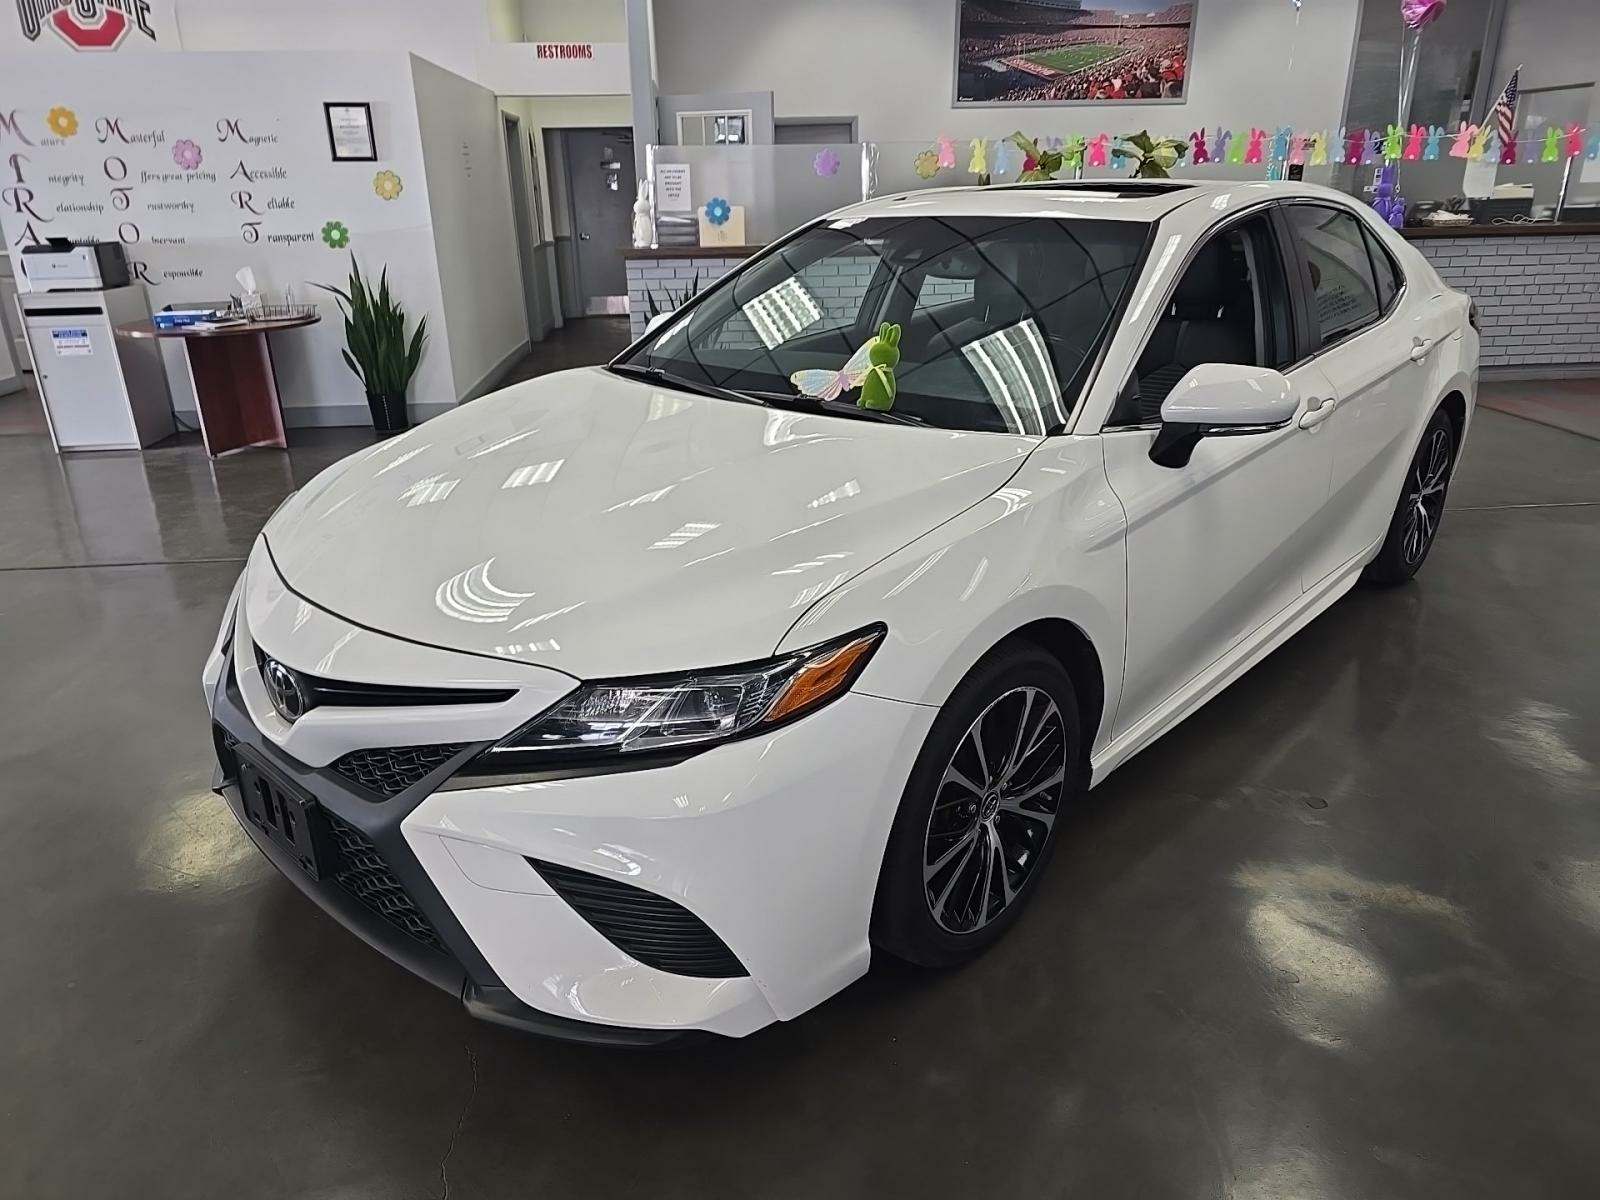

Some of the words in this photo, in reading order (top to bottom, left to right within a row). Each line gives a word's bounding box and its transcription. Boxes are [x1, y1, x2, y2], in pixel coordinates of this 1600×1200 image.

[536, 44, 592, 59] RESTROOMS
[95, 117, 166, 148] Masterful
[216, 118, 277, 145] Magnetic
[186, 170, 217, 183] pricing
[230, 160, 287, 182] Accessible
